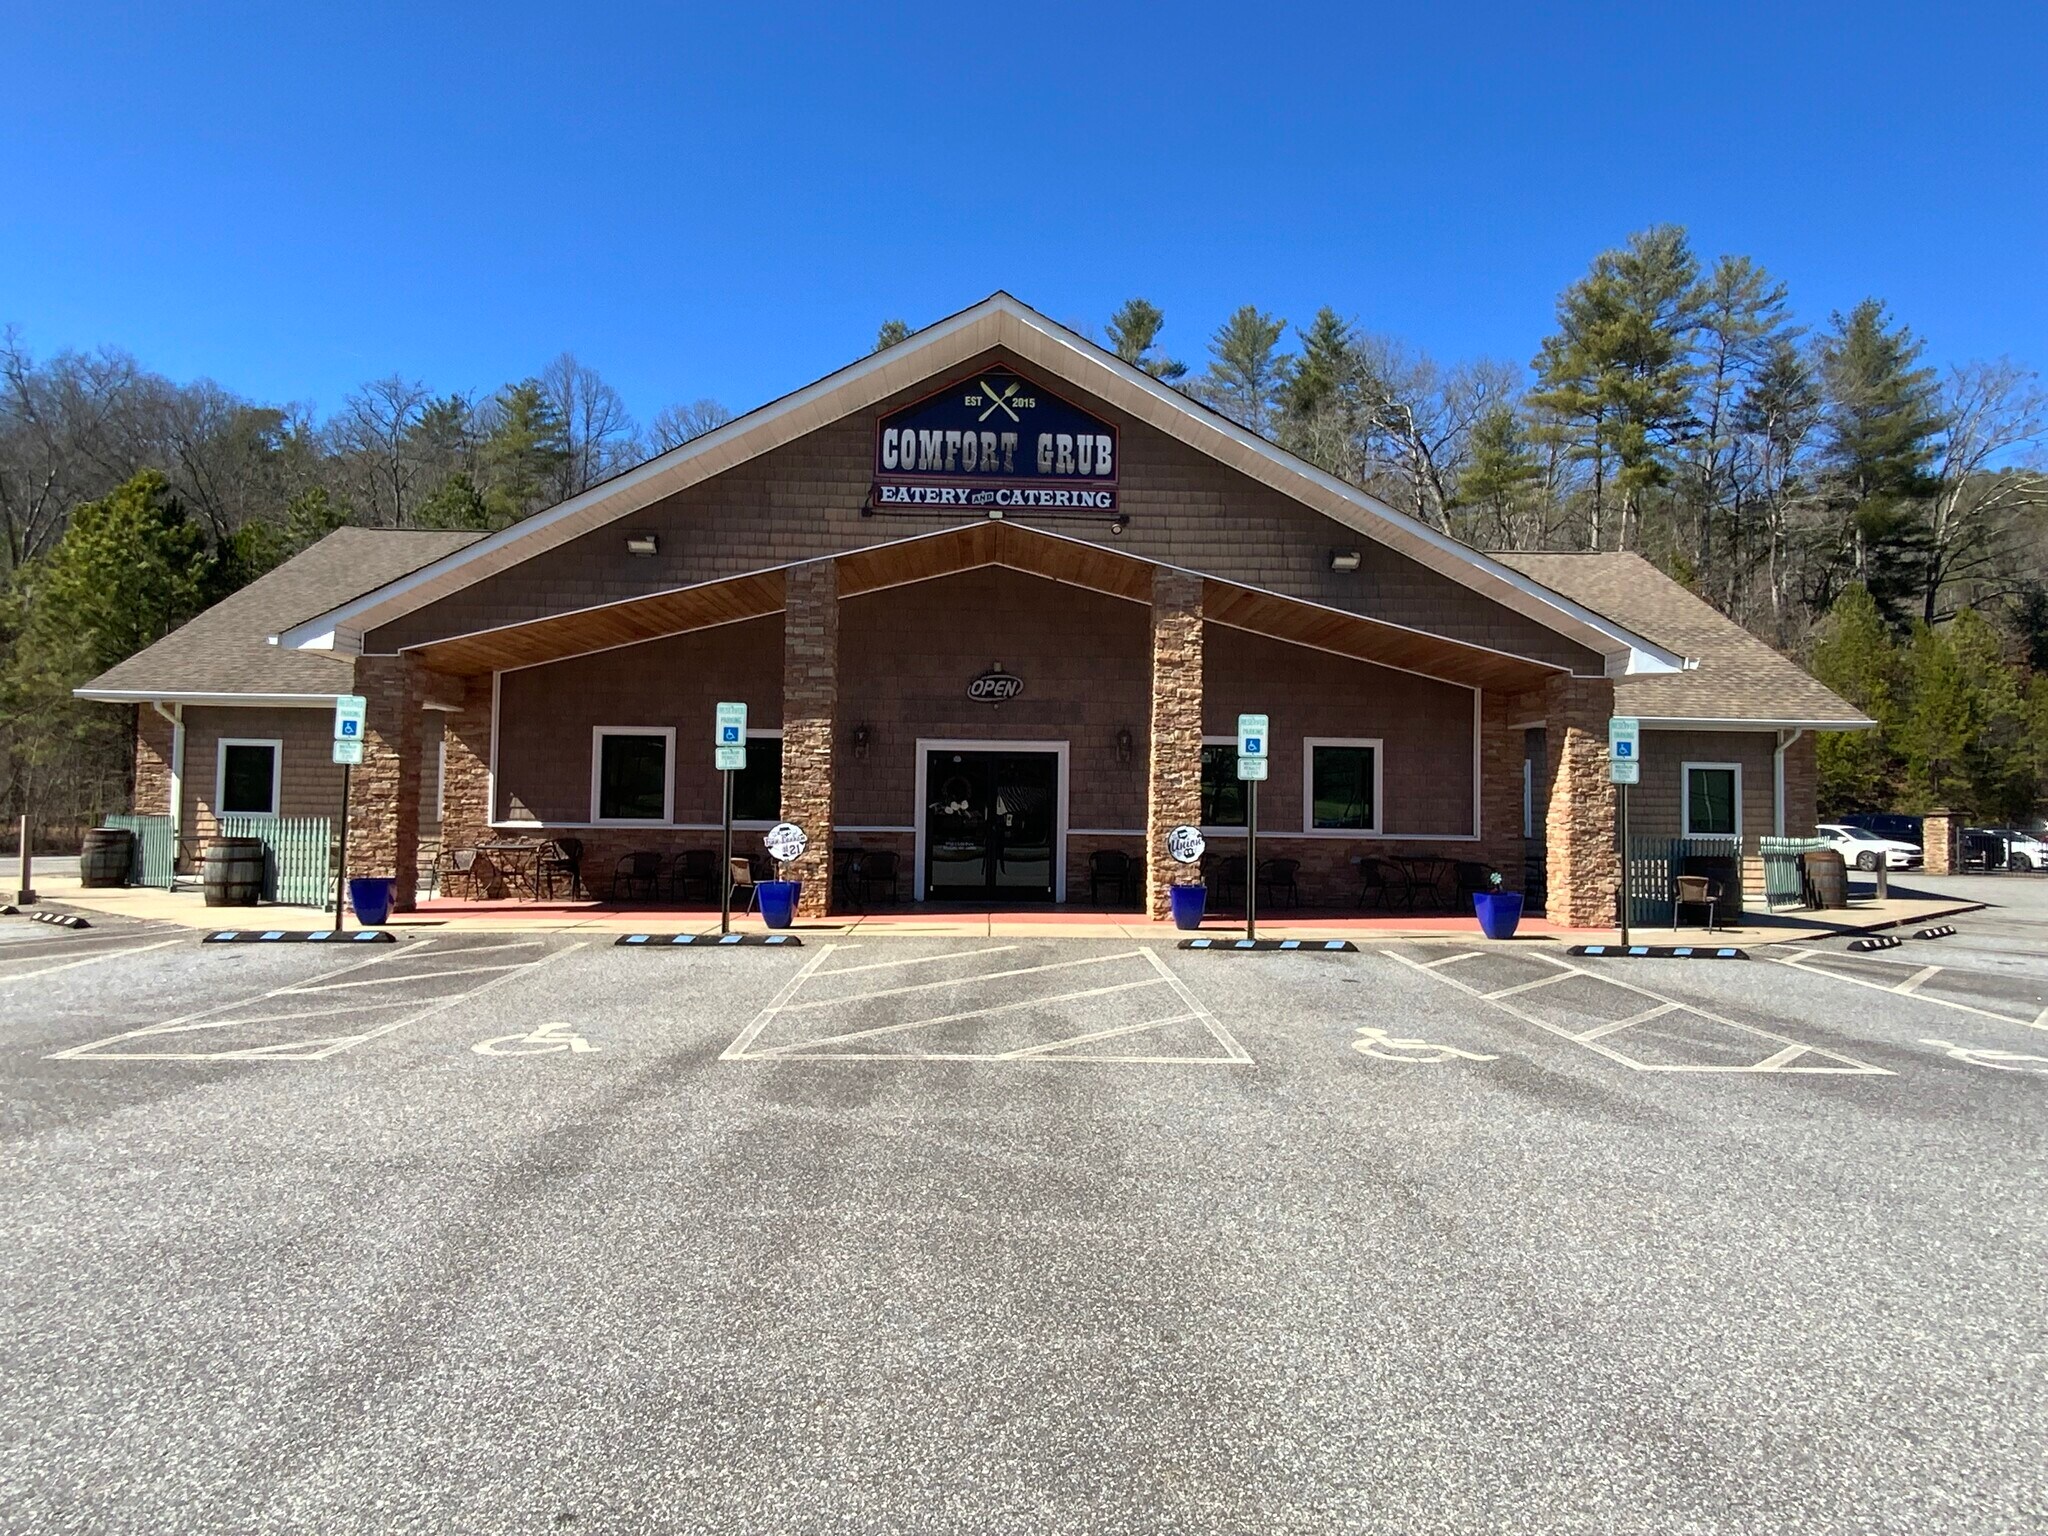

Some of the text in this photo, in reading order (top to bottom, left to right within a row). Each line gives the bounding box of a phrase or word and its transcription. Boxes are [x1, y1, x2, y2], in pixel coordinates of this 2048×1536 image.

[965, 396, 1036, 408] EST 2015
[882, 428, 1112, 475] COMFORT GRUB
[880, 486, 1112, 508] EATERY AND CATERING
[971, 680, 1018, 697] OPEN
[1171, 838, 1202, 852] Union
